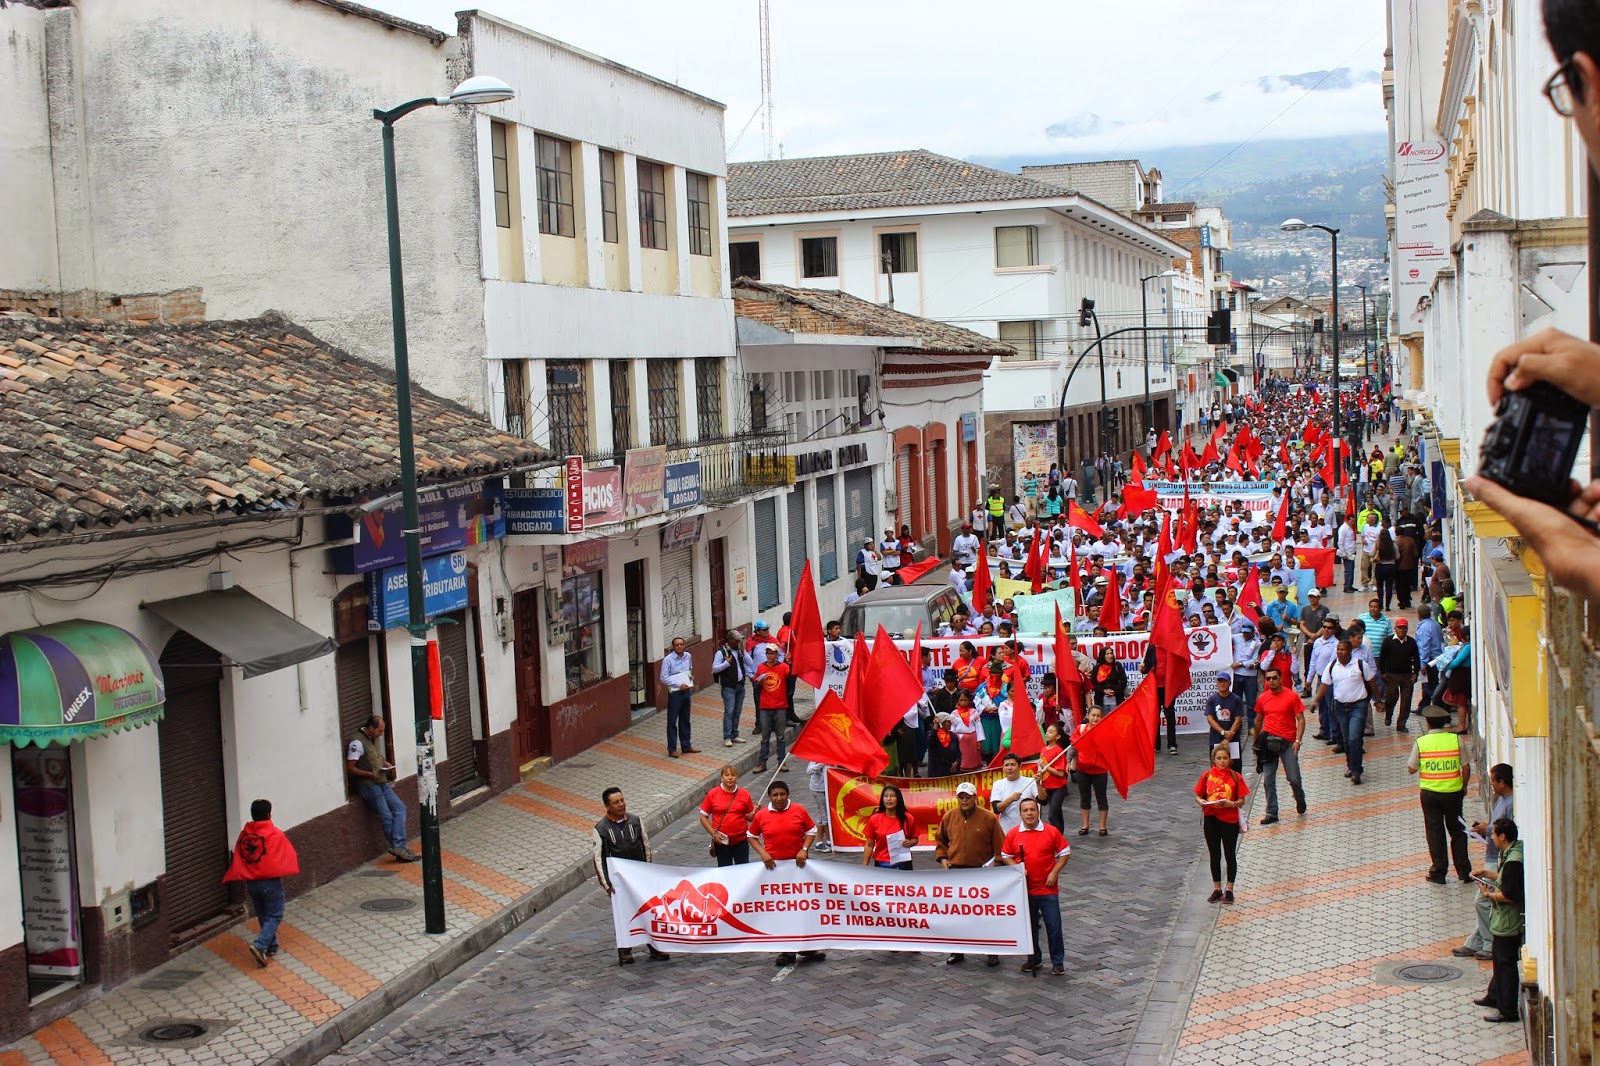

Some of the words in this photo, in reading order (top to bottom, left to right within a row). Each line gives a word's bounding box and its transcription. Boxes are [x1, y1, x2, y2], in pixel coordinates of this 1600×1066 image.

[1411, 222, 1428, 230] Chips
[504, 490, 532, 499] ESTUDIO
[672, 490, 698, 506] ABOGADO
[511, 522, 552, 532] ABOGADO
[63, 686, 93, 722] UNISEX
[1425, 760, 1458, 771] POLICIA
[760, 883, 823, 896] FRENTE
[828, 883, 848, 895] DE
[853, 884, 927, 898] DEFENSA
[932, 886, 953, 898] DE
[958, 887, 990, 899] LOS
[732, 899, 821, 914] DERECHOS
[825, 899, 846, 911] DE
[850, 901, 881, 913] LOS
[886, 901, 1017, 916] TRABAJADORES
[657, 922, 712, 935] FDDT-I
[820, 914, 841, 925] DE
[846, 914, 930, 929] IMBABURA
